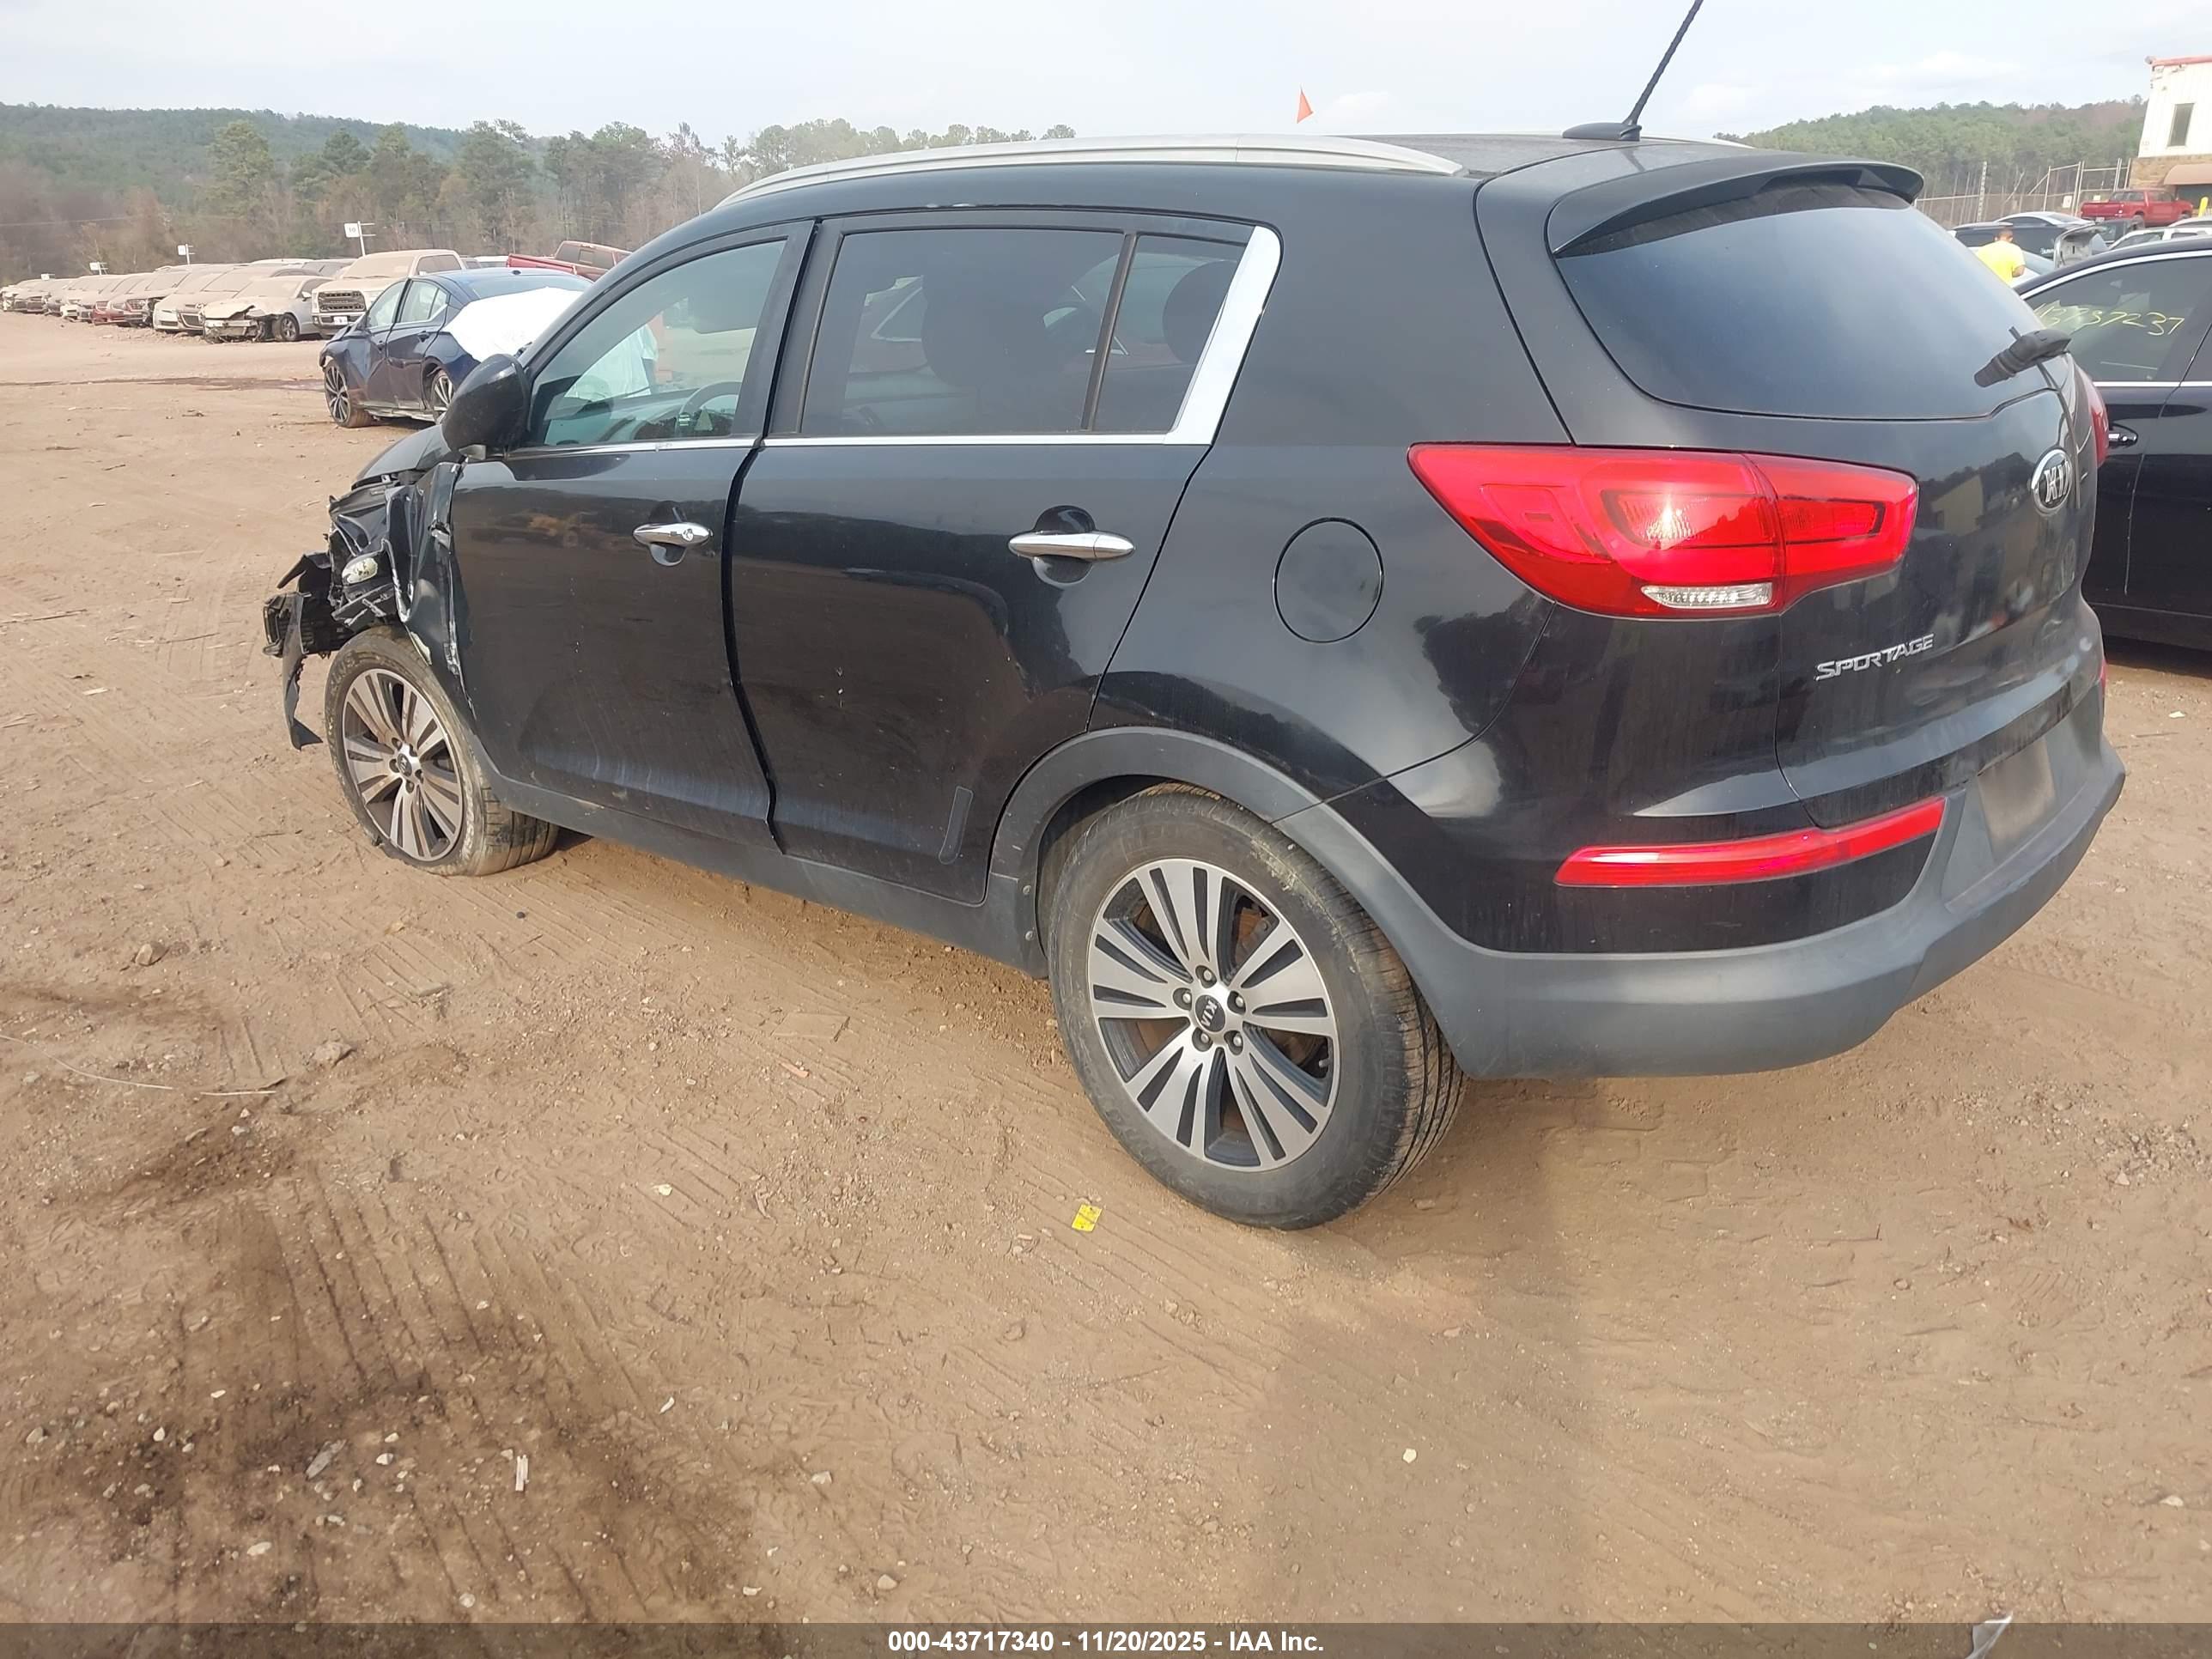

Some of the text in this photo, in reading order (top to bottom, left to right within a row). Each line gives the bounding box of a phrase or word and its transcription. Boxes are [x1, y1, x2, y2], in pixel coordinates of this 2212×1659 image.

[2044, 459, 2070, 502] KIA
[1815, 634, 1934, 681] SPORTAGE
[1200, 1000, 1218, 1027] KIA
